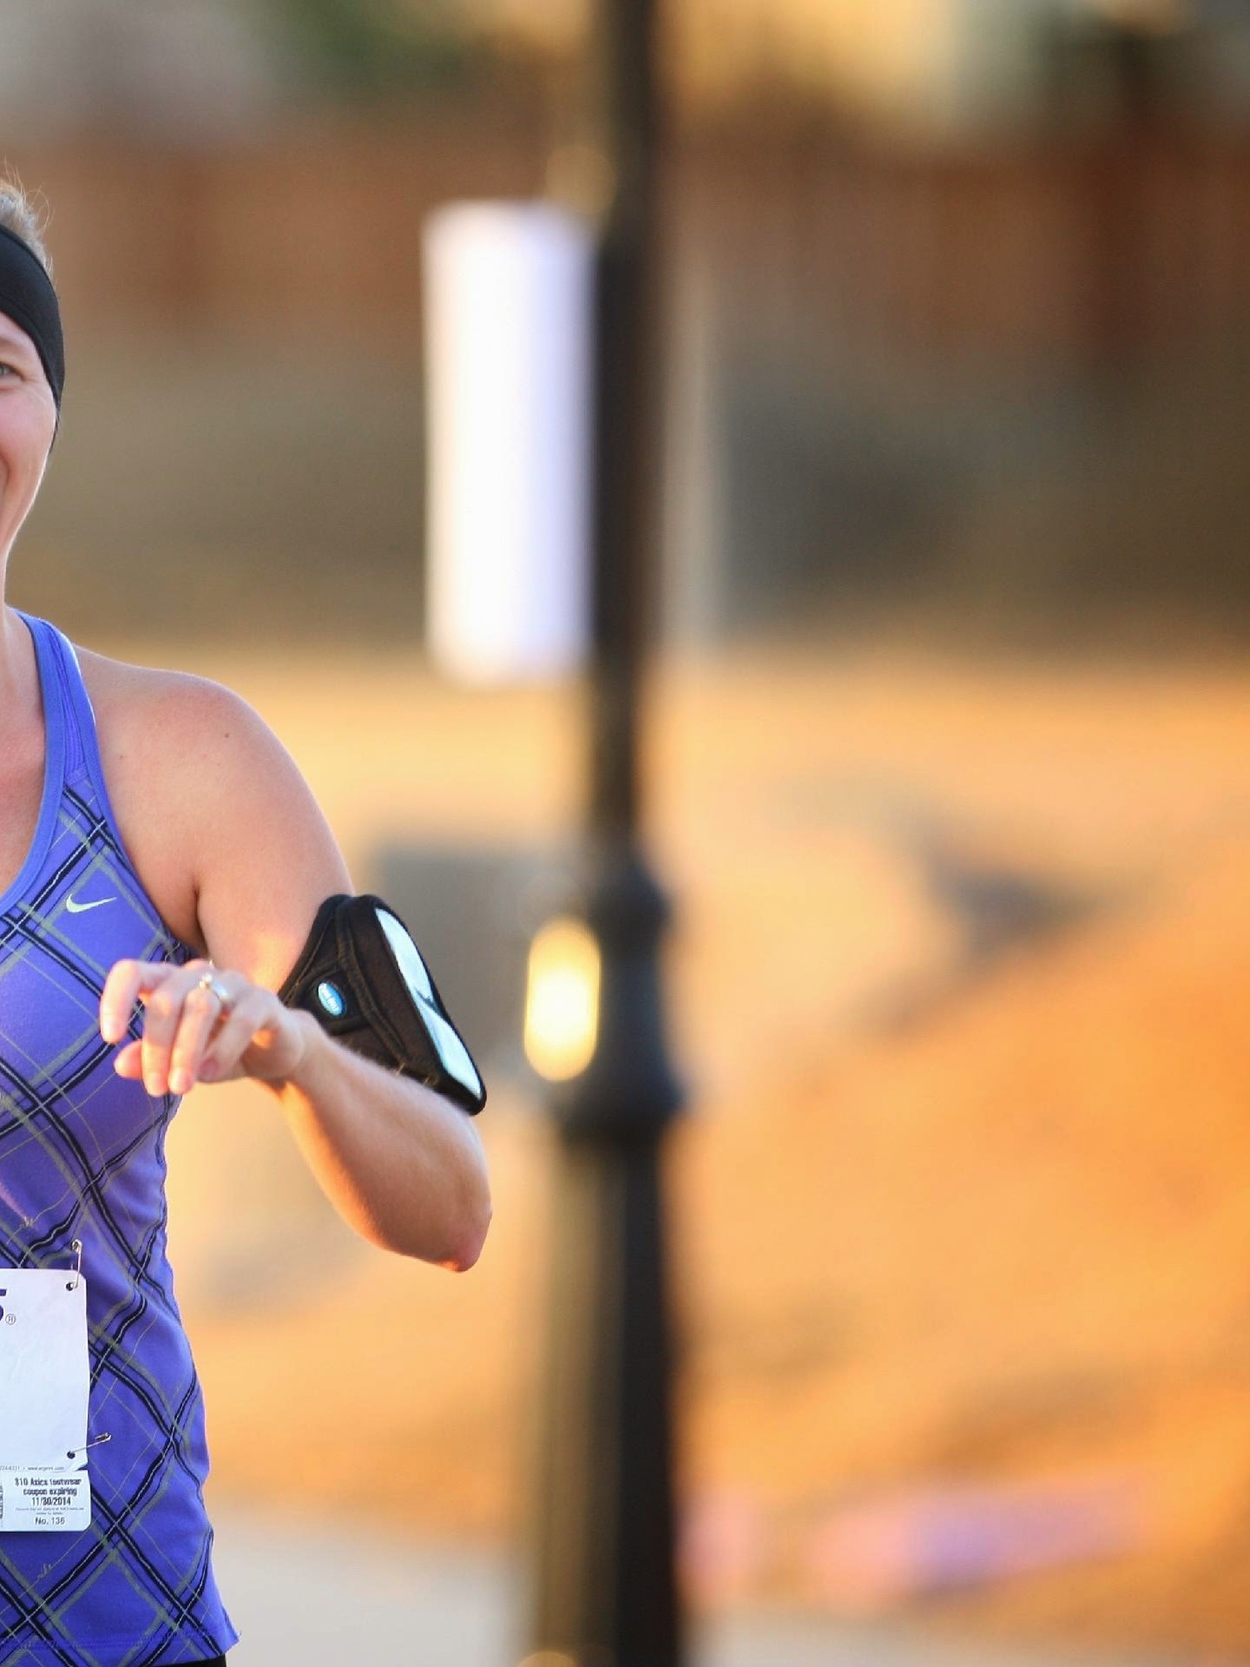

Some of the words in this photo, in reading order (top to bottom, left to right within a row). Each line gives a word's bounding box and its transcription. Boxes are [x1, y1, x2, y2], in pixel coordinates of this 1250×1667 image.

[23, 1488, 48, 1496] coupon
[49, 1487, 77, 1496] expiring
[31, 1497, 71, 1506] 11/30/2014
[35, 1517, 49, 1525] No.
[51, 1517, 66, 1525] 136
